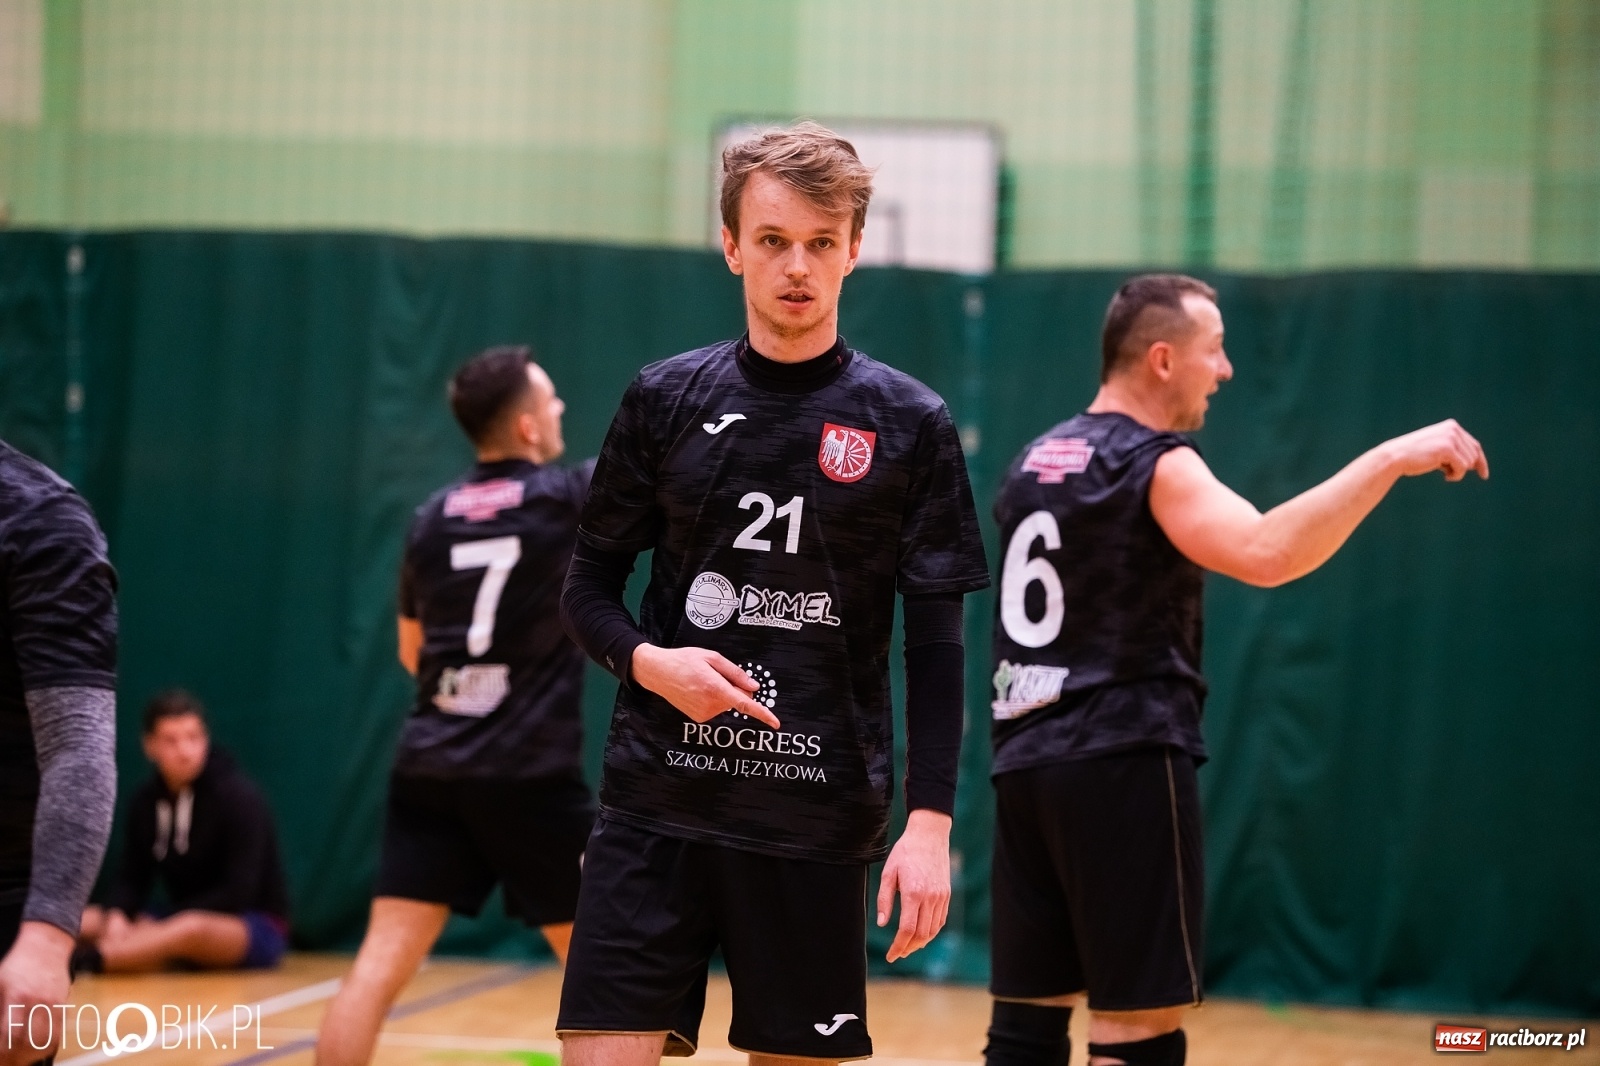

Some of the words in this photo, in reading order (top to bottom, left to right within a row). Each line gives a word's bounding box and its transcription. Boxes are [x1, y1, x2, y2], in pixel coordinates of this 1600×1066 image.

[733, 492, 804, 554] 21
[450, 535, 521, 657] 7
[695, 575, 729, 592] CULINARY
[1001, 510, 1065, 648] 6
[690, 610, 725, 625] STUDIO
[740, 585, 841, 626] DYMEL
[682, 722, 821, 757] PROGRESS
[665, 750, 729, 773] SZKOŁA
[732, 758, 827, 783] JĘZYKOWA
